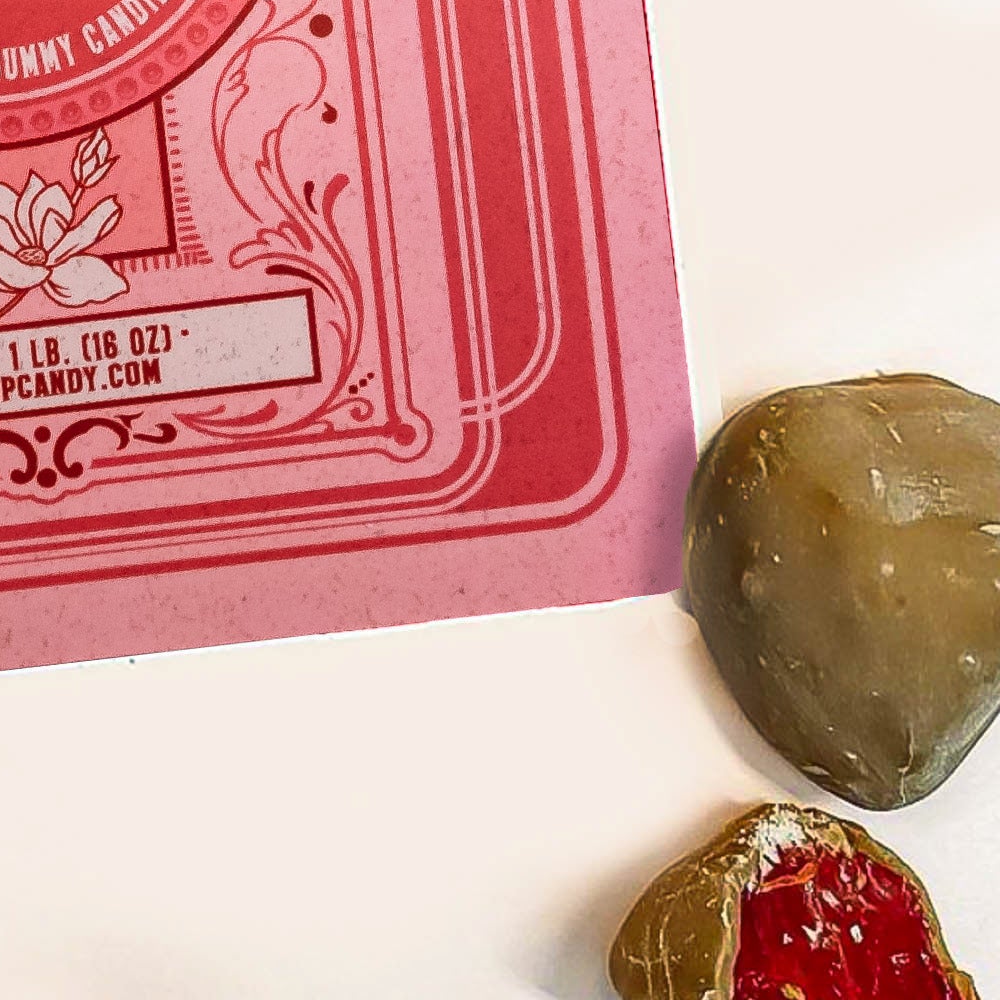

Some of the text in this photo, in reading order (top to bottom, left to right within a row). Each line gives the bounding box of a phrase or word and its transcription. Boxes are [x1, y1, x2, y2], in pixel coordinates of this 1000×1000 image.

[8, 343, 19, 370] 1
[31, 338, 70, 369] LB.
[82, 329, 118, 362] (16
[129, 324, 172, 355] OZ)
